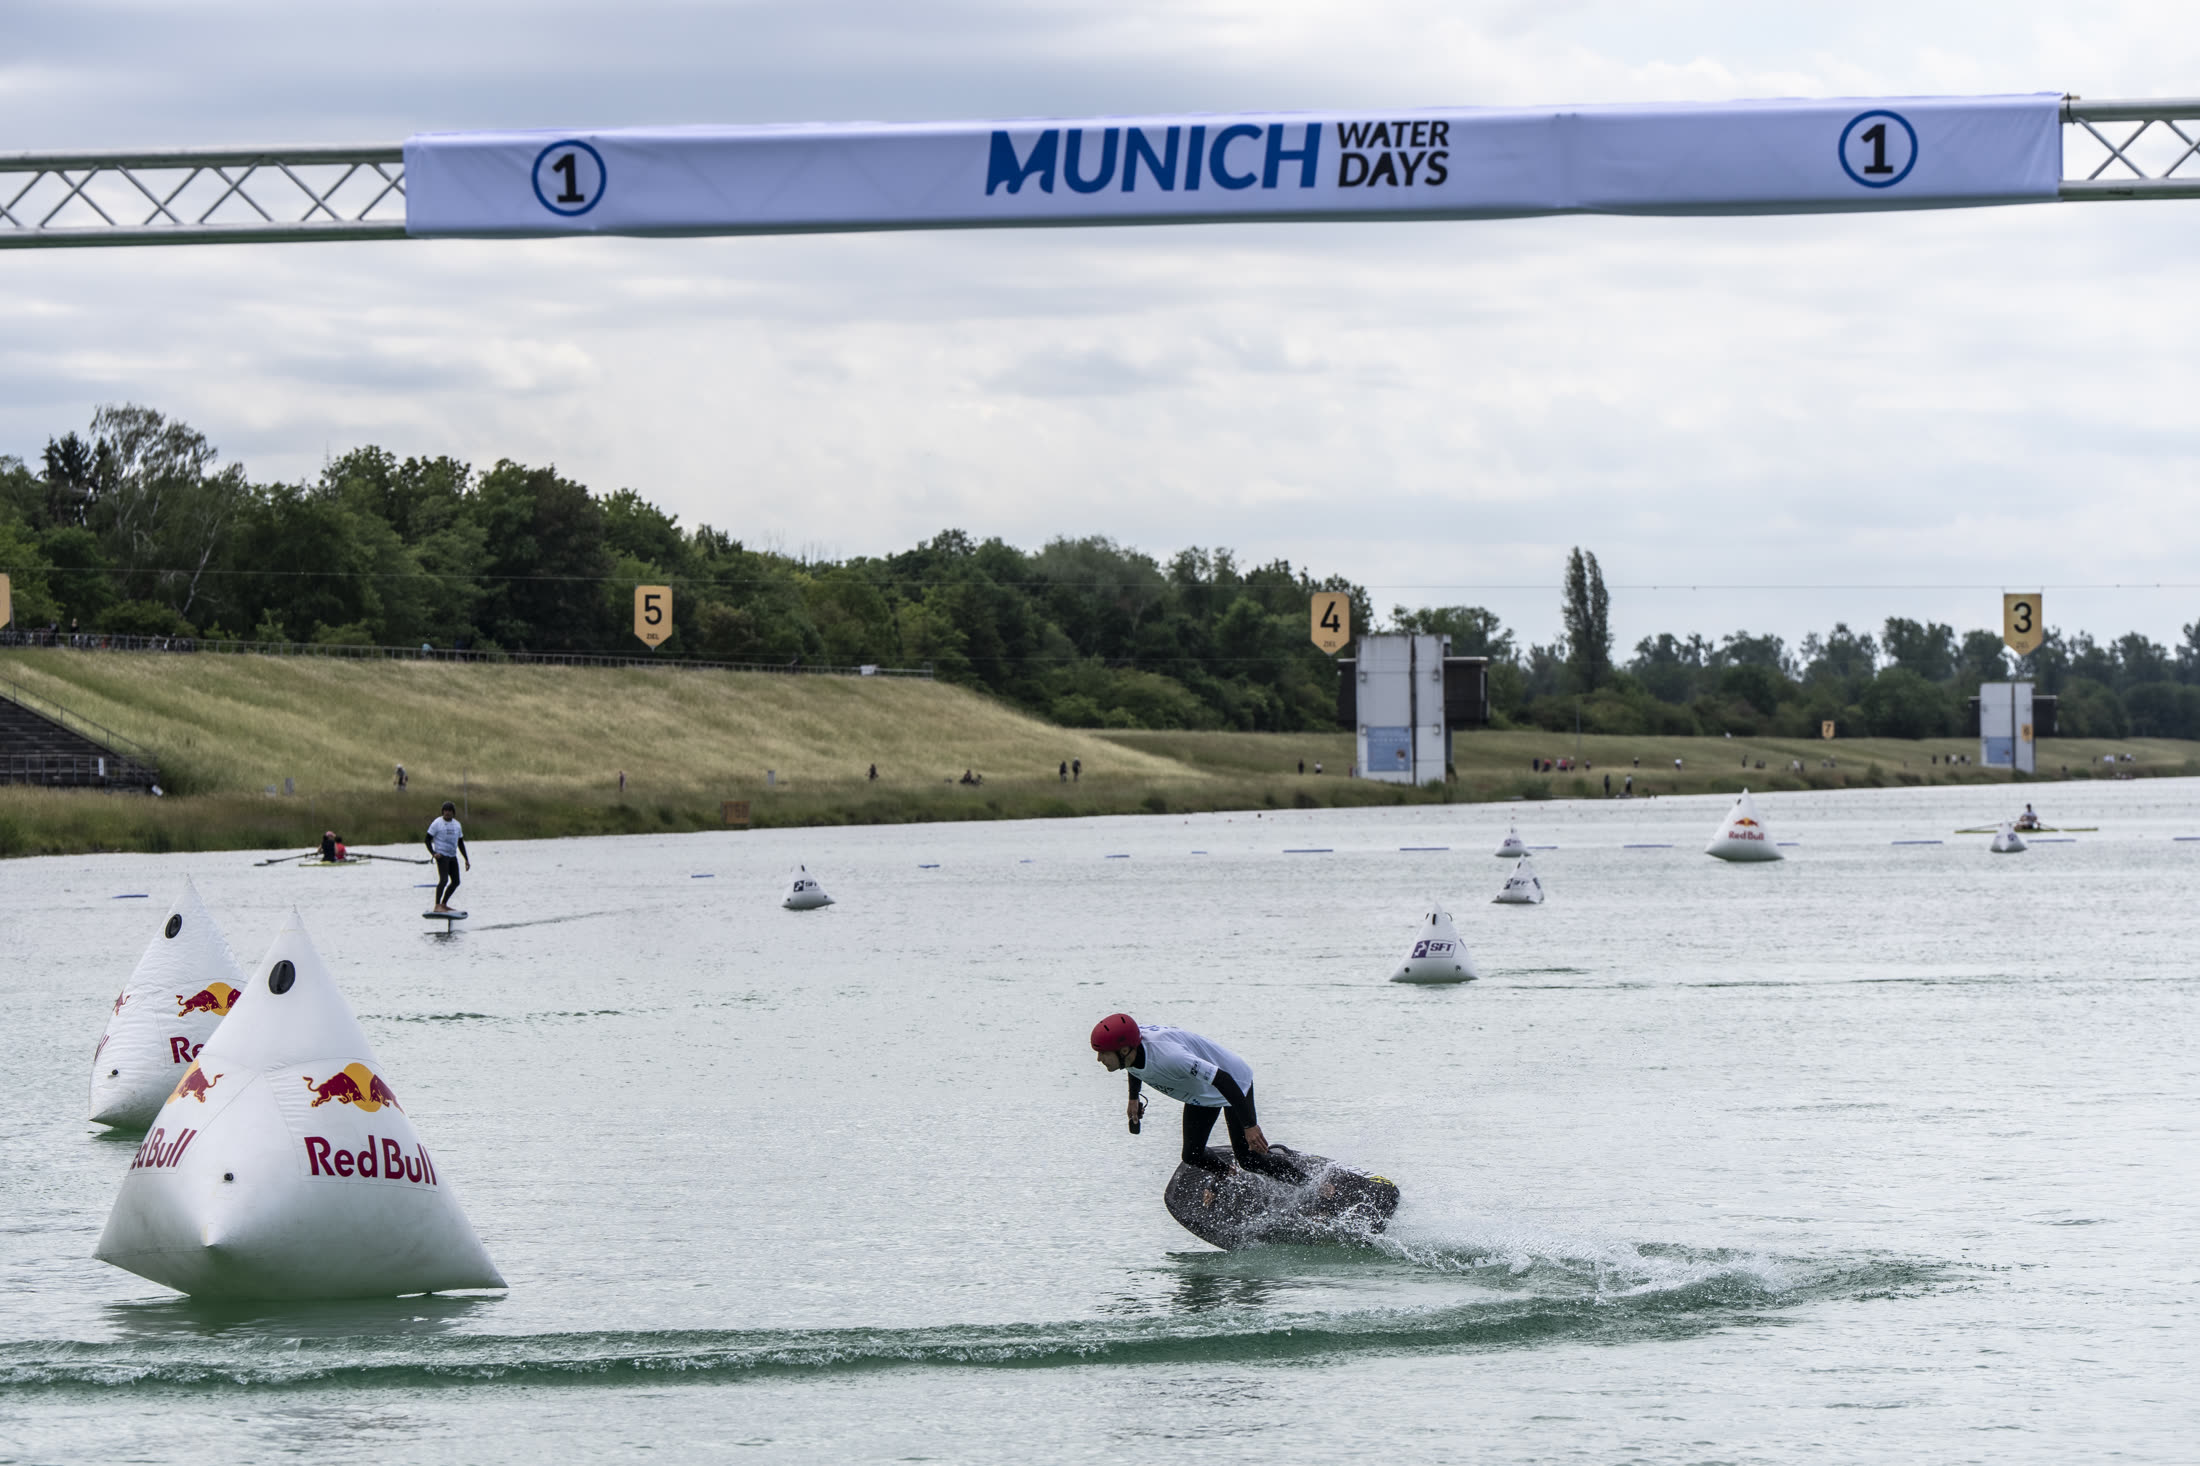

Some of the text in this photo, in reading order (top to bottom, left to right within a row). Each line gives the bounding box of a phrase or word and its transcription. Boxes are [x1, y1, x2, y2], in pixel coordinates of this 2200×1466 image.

[1337, 120, 1450, 149] WATER
[1861, 123, 1894, 174] 1
[552, 133, 584, 183] 1
[985, 122, 1323, 196] MUNICH
[1337, 150, 1449, 188] DAYS
[645, 594, 662, 625] 5
[1320, 601, 1341, 633] 4
[2013, 601, 2032, 633] 3
[1825, 723, 1831, 733] 7
[1728, 830, 1764, 841] Red Bull
[1430, 942, 1454, 952] SFT
[170, 1036, 205, 1064] Re
[145, 1128, 197, 1168] Bull
[304, 1134, 437, 1186] Red Bull
